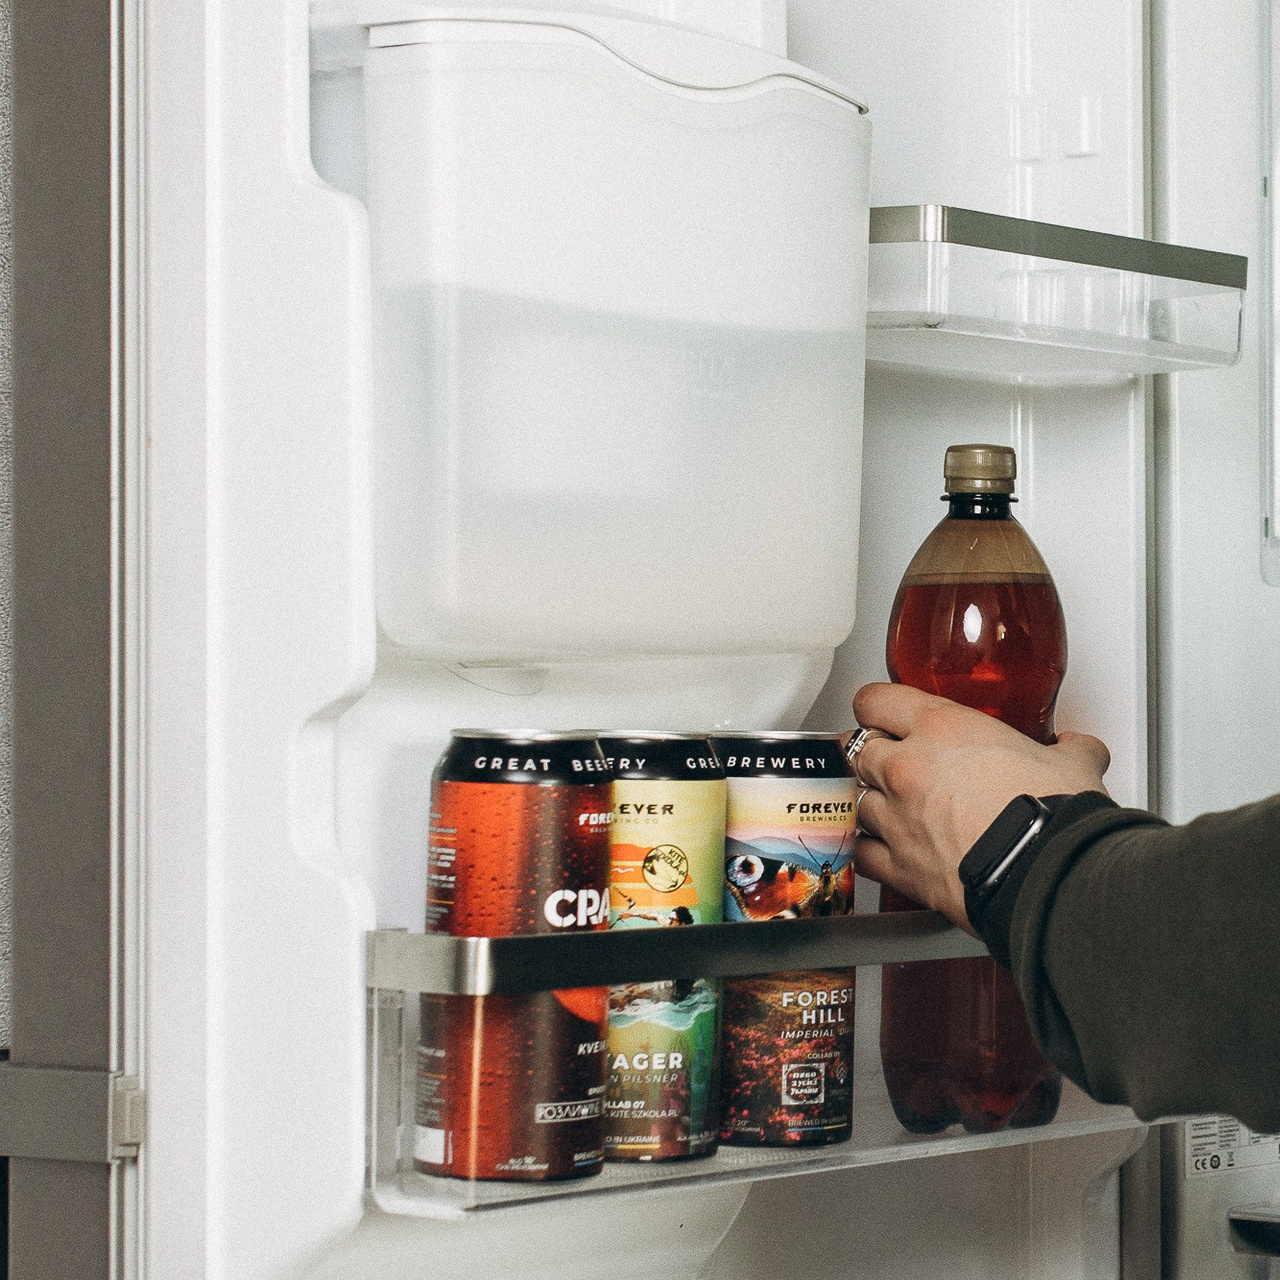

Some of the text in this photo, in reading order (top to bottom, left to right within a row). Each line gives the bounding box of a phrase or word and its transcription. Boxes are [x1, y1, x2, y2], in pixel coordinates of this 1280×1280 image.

[474, 756, 551, 771] GREAT
[727, 756, 826, 769] BREWERY
[613, 803, 674, 815] EVER
[786, 801, 853, 814] FOREVER
[543, 887, 610, 928] CPA
[782, 988, 854, 1007] FOREST
[802, 1007, 845, 1025] HILL
[780, 1028, 836, 1039] IMPERIAL
[607, 1052, 683, 1070] AGER
[807, 1051, 833, 1060] COLLAB
[623, 1073, 679, 1084] PILSNER
